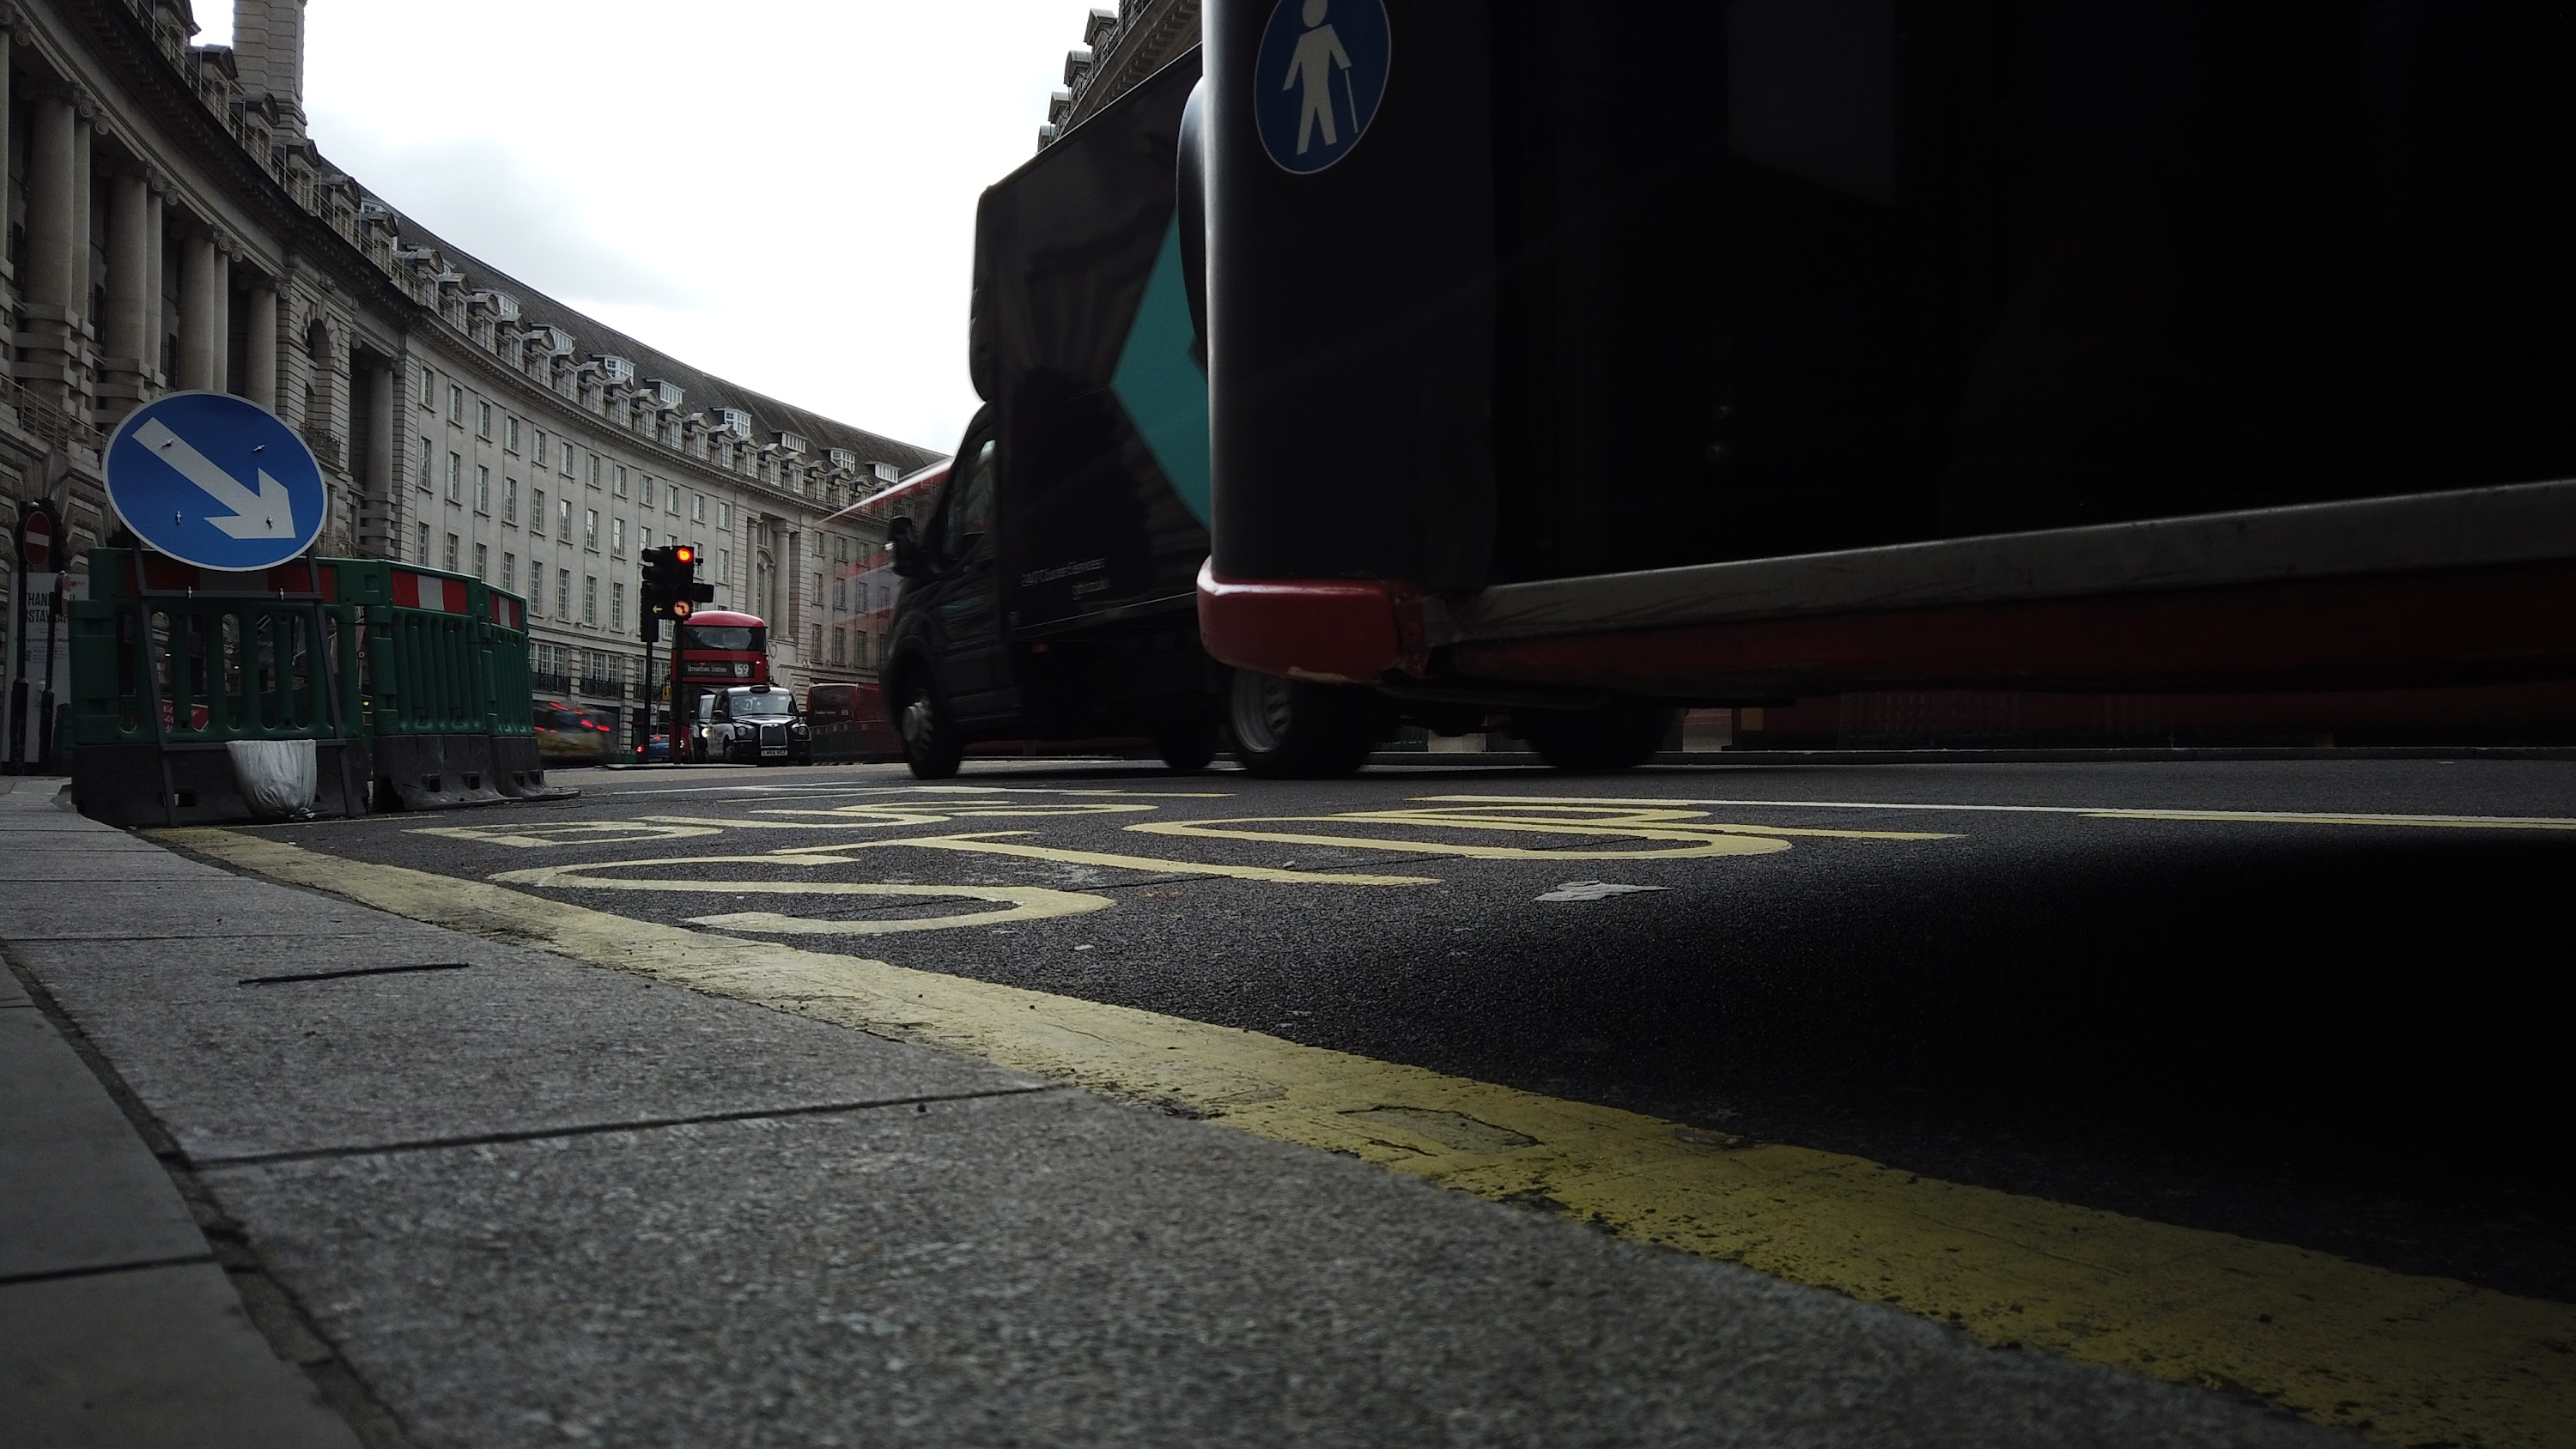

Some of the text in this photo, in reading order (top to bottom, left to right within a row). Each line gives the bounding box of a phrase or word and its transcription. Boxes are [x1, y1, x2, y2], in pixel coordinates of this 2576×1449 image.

[734, 664, 750, 674] 159
[402, 800, 1159, 847] BUS
[486, 805, 1968, 934] STOP
